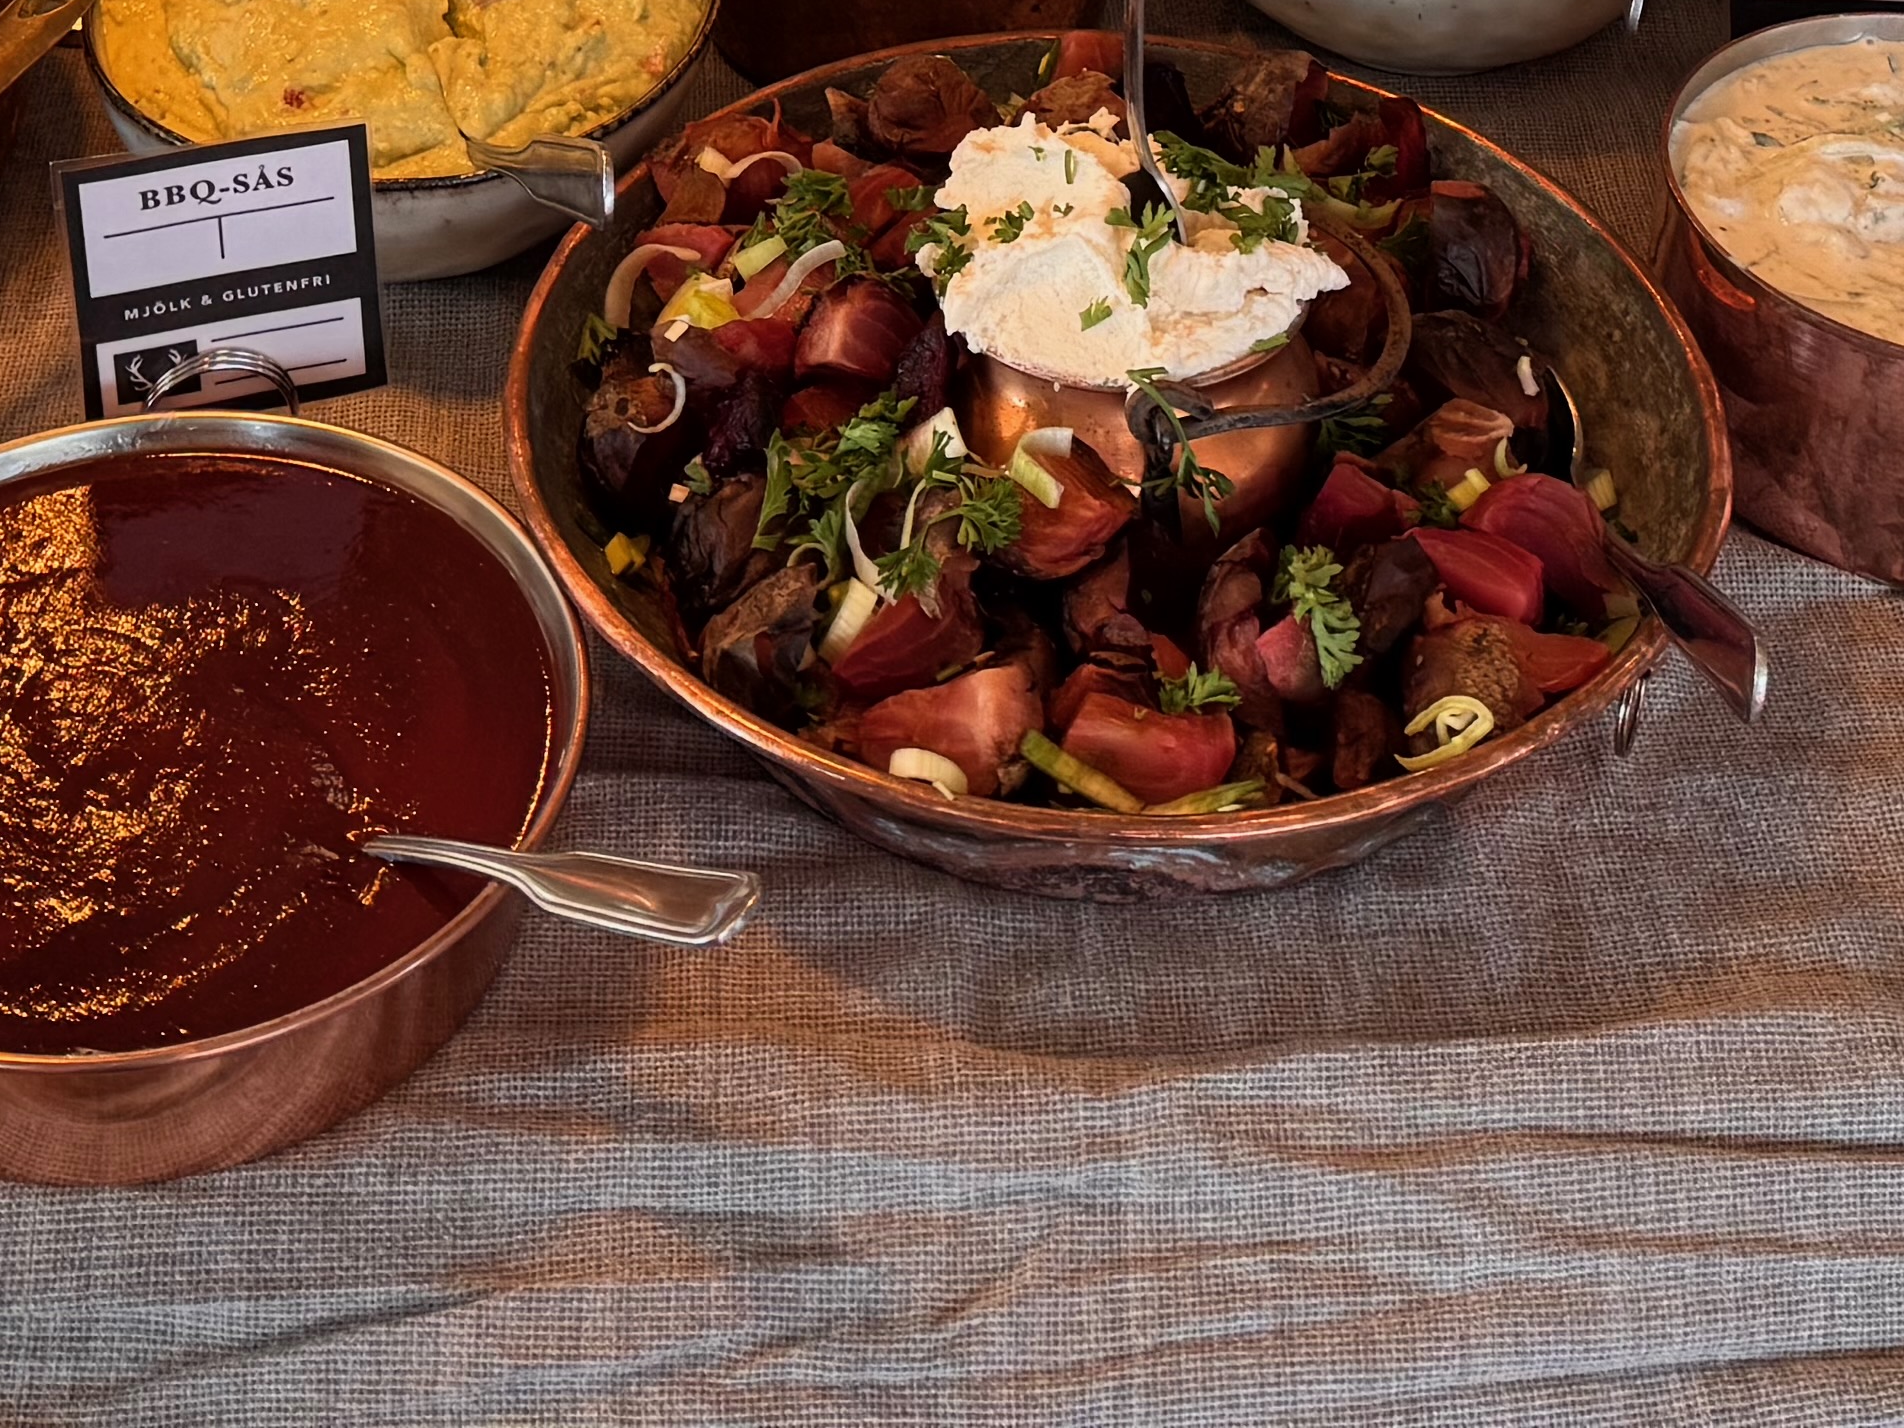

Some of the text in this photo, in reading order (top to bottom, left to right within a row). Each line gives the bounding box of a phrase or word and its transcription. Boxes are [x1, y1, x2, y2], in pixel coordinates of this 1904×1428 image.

[139, 164, 295, 210] BBQ-SÅS
[124, 274, 331, 321] MJÖLK & GLUTENFRI
